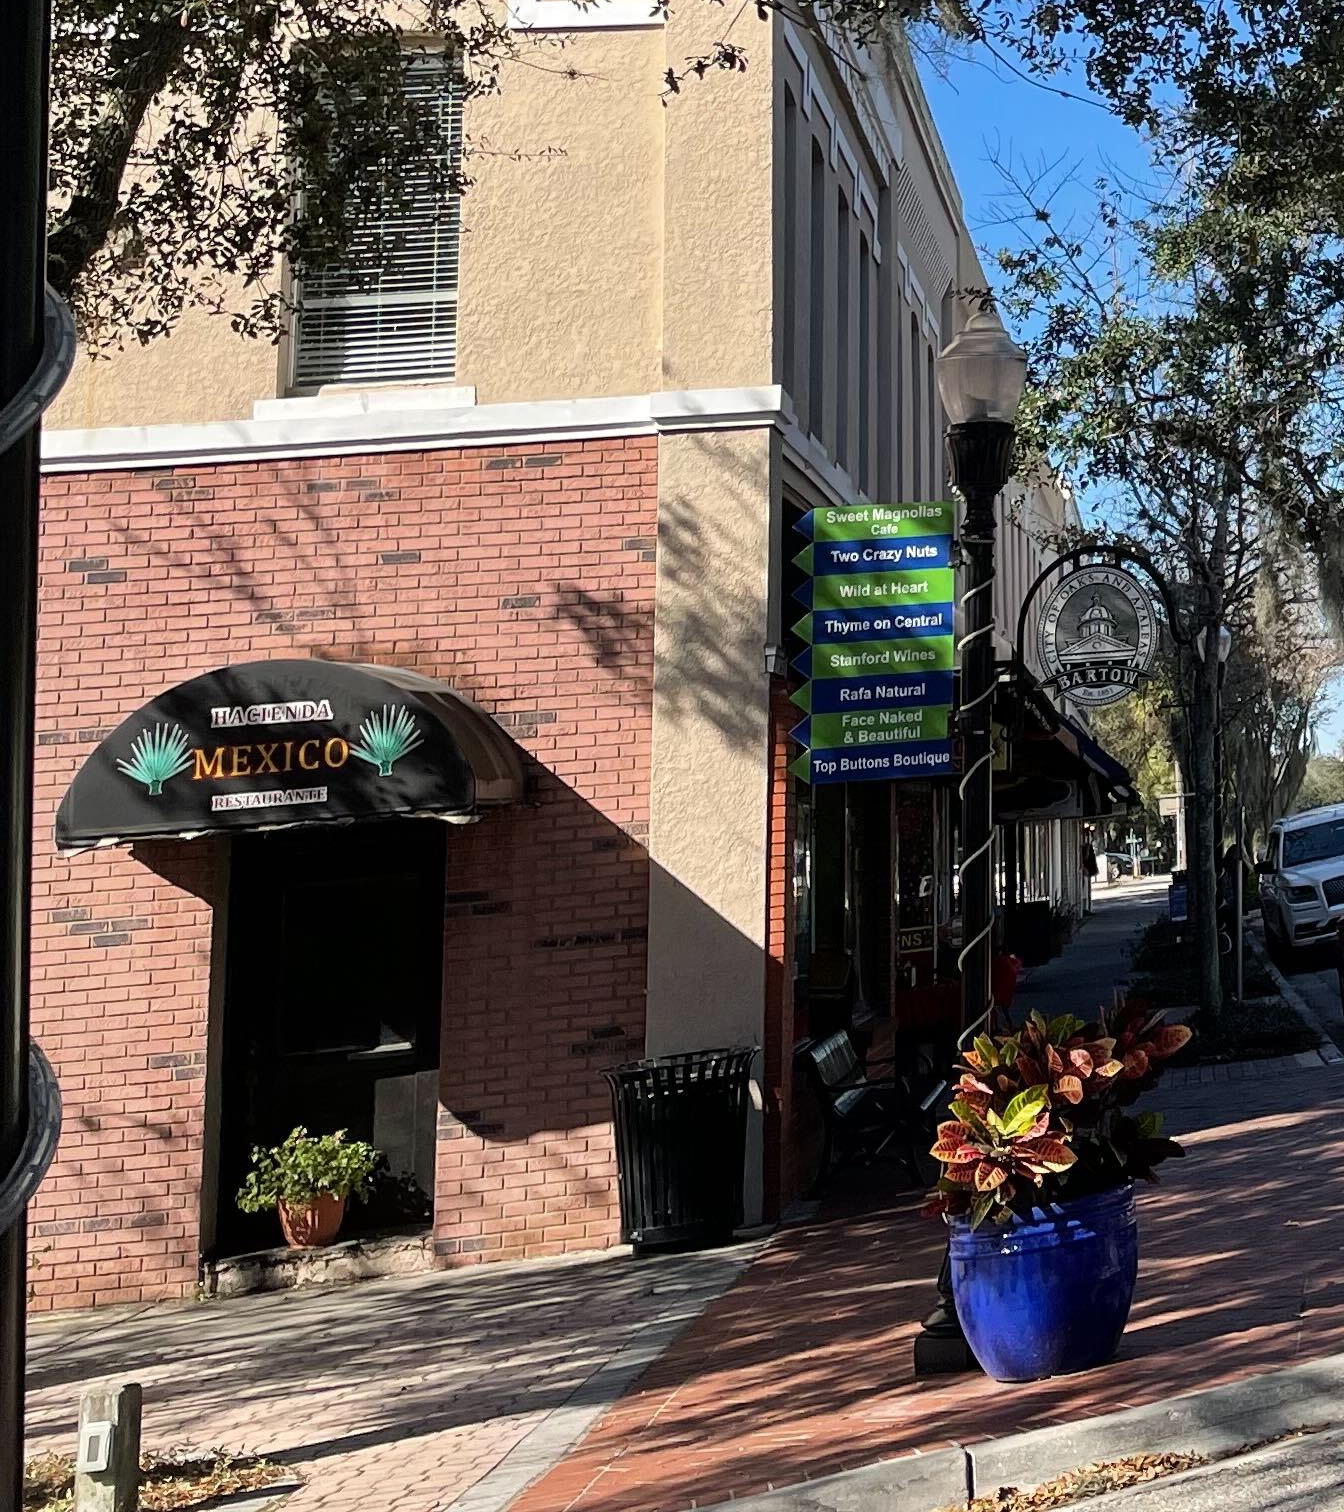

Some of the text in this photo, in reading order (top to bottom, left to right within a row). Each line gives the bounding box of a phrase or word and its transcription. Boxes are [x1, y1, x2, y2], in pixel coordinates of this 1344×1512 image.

[826, 506, 942, 524] Sweet Magnolias
[871, 523, 898, 536] Cafe
[830, 544, 938, 566] Two Crazy Nuts
[839, 580, 928, 598] Wild at Heart
[825, 612, 942, 635] Thyme on Central
[1044, 574, 1150, 664] CITY OF OAKS AND AZALEAS
[830, 649, 935, 668] Stanford Wines
[1056, 669, 1138, 689] BARTOW
[840, 682, 926, 702] Rafa Natural
[213, 702, 331, 725] HACIENDA
[842, 709, 923, 727] Face Naked
[843, 726, 921, 743] & Beautiful
[193, 737, 350, 780] MEXICO
[814, 751, 950, 774] Top Buttons Boutique
[212, 788, 327, 810] RESTAURANTE
